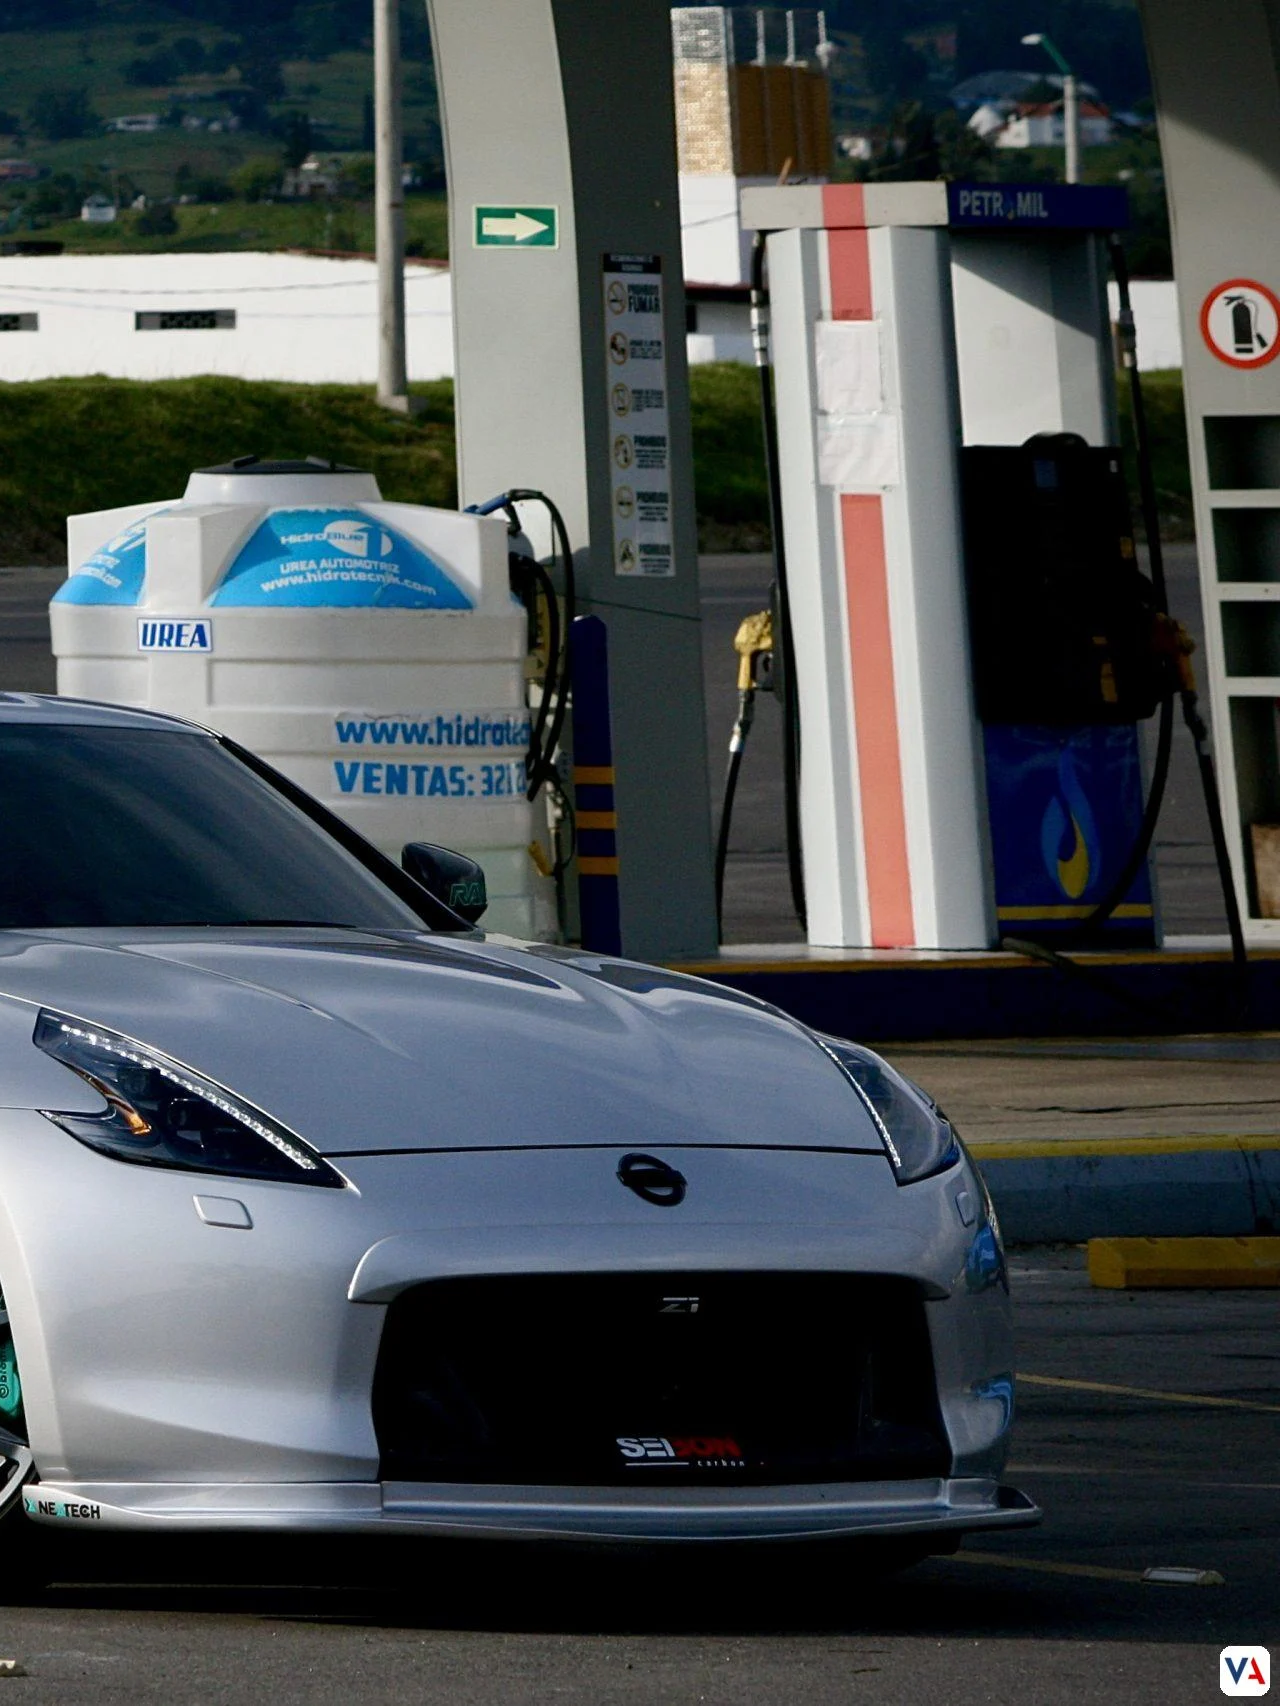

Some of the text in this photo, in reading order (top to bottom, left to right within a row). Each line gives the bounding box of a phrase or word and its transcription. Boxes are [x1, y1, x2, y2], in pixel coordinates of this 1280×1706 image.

[959, 190, 1049, 219] PETRMIL
[280, 557, 400, 574] UREA AUTOMOTRIZ
[260, 569, 437, 596] www.hidrotecnik.com
[141, 623, 208, 648] UREA
[334, 761, 475, 797] VENTAS:
